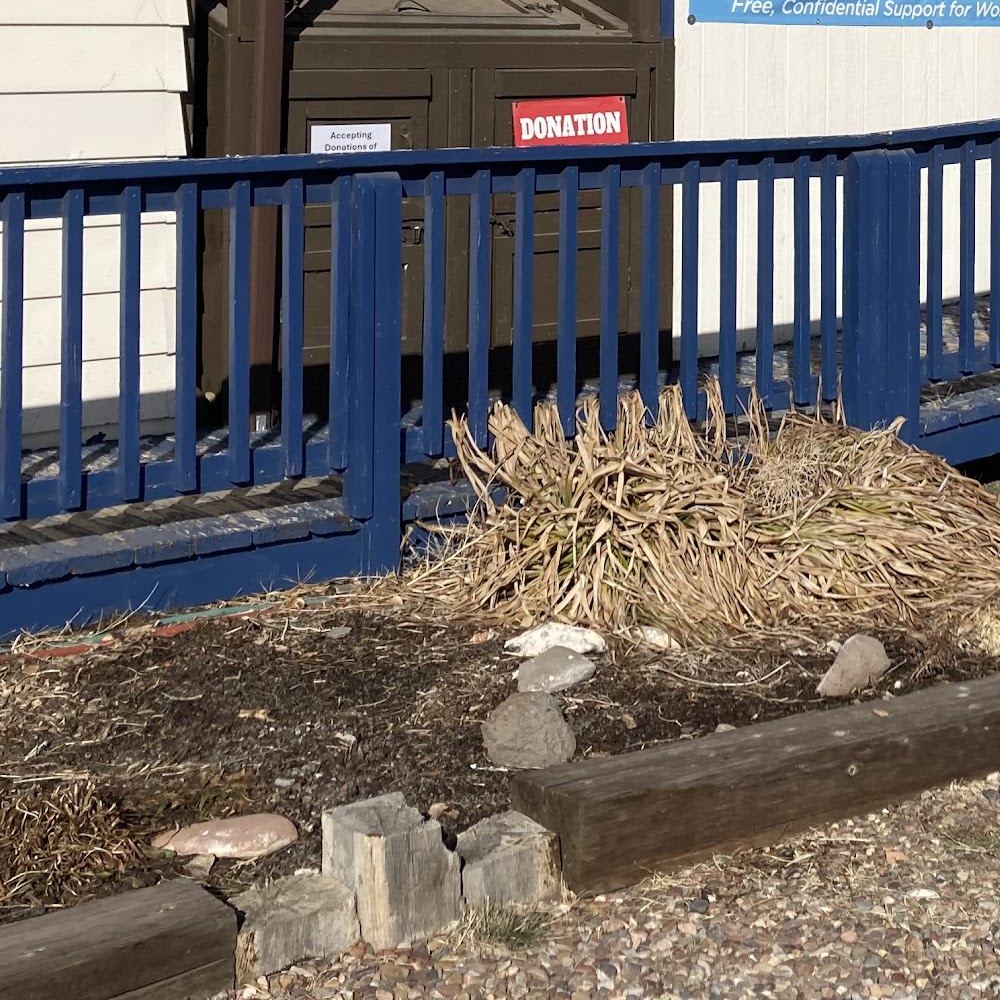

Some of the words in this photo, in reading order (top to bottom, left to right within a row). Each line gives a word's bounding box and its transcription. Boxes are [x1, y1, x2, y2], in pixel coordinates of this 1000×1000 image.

[883, 0, 944, 20] Support
[949, 1, 972, 18] for
[520, 111, 621, 141] DONATION
[330, 131, 372, 141] Accepting
[324, 143, 367, 152] Donations
[368, 142, 378, 150] of
